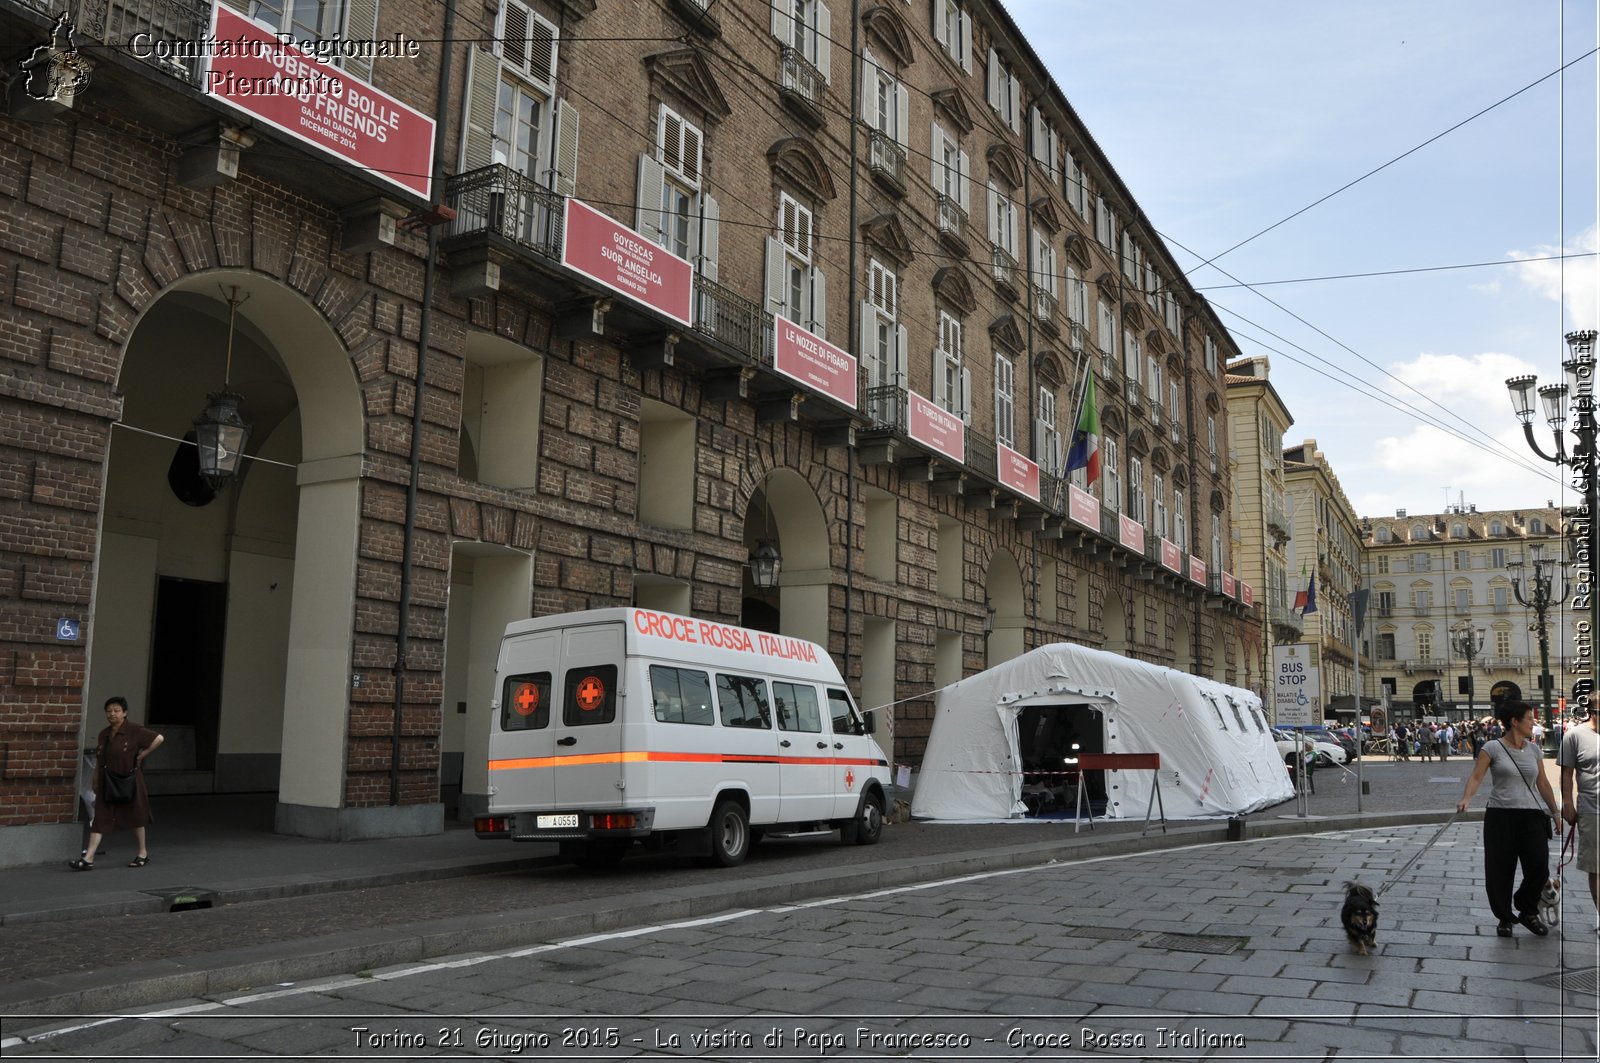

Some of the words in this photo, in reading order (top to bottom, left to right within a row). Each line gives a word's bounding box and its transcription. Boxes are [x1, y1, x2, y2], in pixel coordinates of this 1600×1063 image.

[301, 105, 322, 123] GALA
[323, 117, 331, 127] DI
[332, 122, 358, 140] DANZA
[315, 94, 387, 143] FRIENDS
[348, 89, 400, 130] BOLLE
[300, 117, 339, 142] DICEMBRE
[340, 136, 357, 151] 2014
[613, 232, 654, 262] GOYESCAS
[601, 246, 623, 266] SUOR
[624, 259, 662, 286] ANGELICA
[616, 274, 637, 289] GENNAIO
[785, 327, 795, 343] LE
[796, 333, 818, 355] NOZZE
[818, 345, 825, 359] DI
[826, 351, 849, 372] FIGARO
[634, 609, 697, 644] CROCE
[699, 622, 755, 653] ROSSA
[758, 633, 818, 664] ITALIANA
[1279, 674, 1307, 686] STOP
[1281, 662, 1303, 673] BUS
[553, 816, 576, 826] A0558
